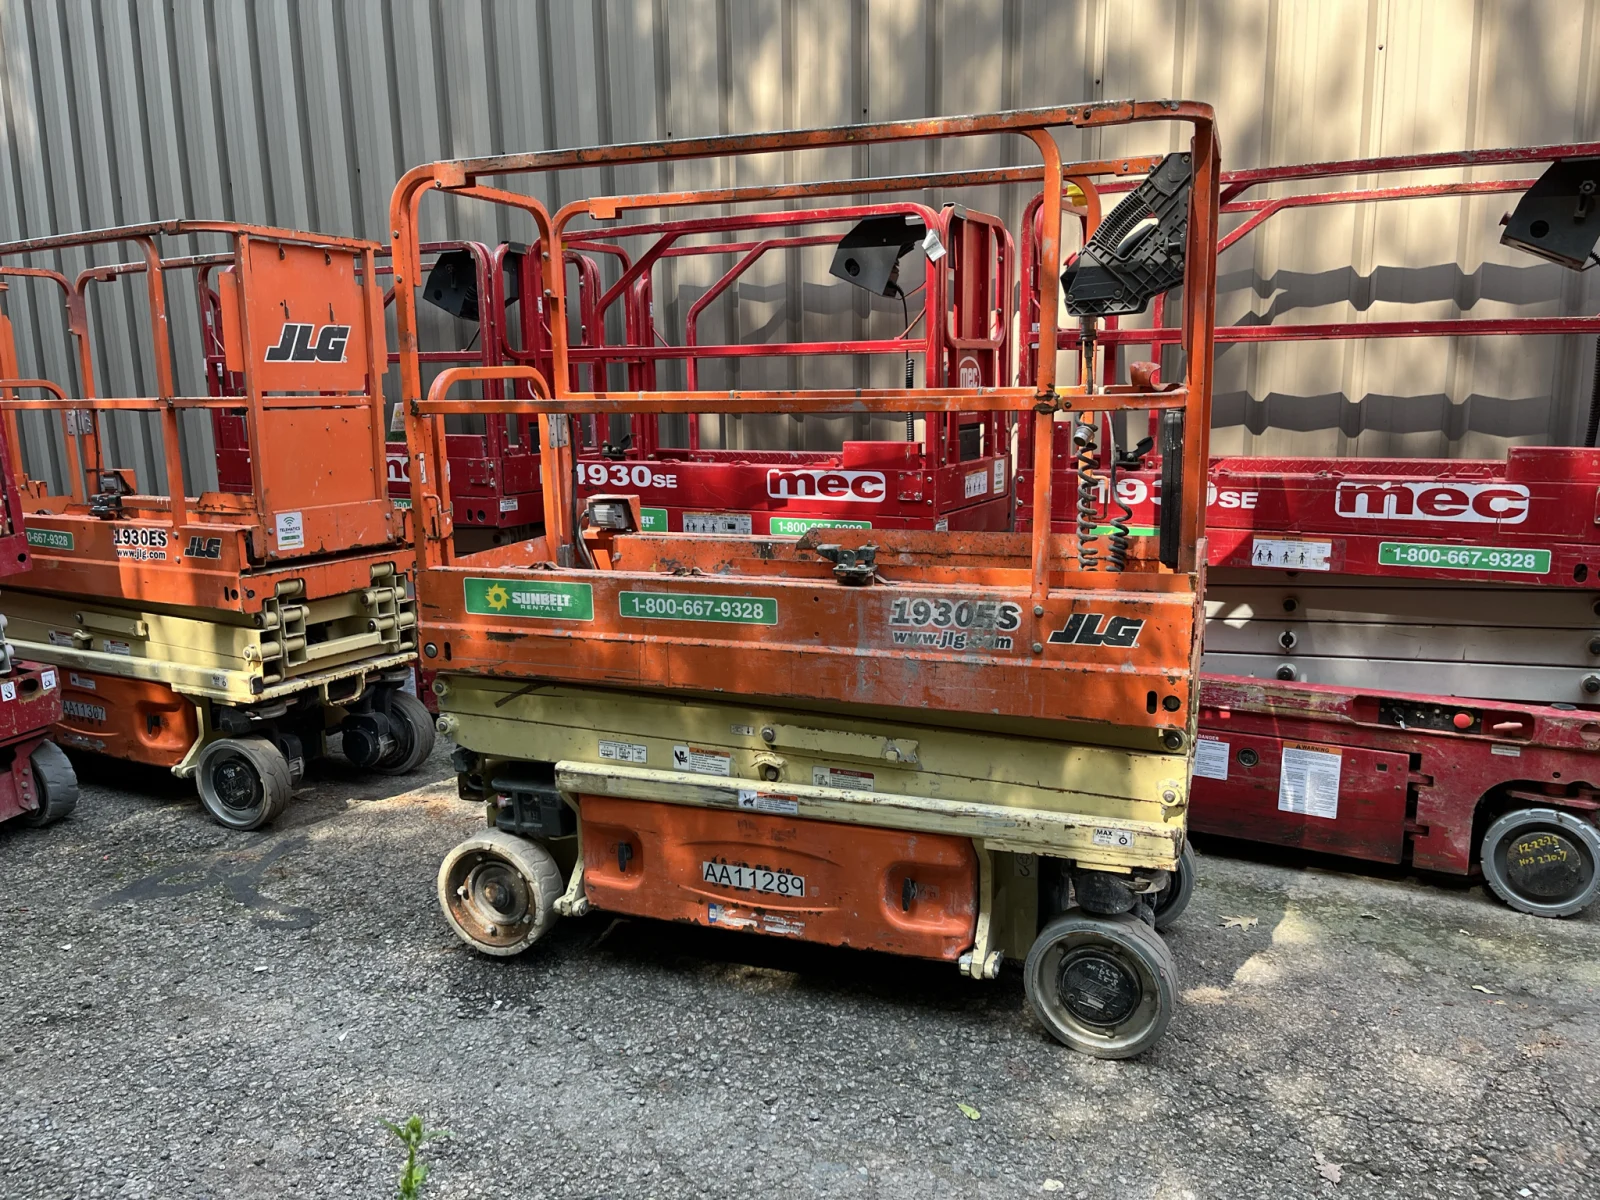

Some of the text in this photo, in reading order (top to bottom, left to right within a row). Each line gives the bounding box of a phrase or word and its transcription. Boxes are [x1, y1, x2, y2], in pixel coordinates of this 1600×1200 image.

[264, 323, 351, 363] JLG
[961, 367, 978, 389] mec
[577, 463, 678, 488] 1930SE
[768, 470, 885, 500] mec
[1338, 483, 1528, 521] mec
[114, 528, 166, 546] 1930ES
[184, 536, 222, 558] JLG
[116, 548, 166, 561] www.jlg.com
[1393, 546, 1536, 569] 1-800-667-9328
[512, 591, 571, 606] SUNBELT
[631, 597, 764, 620] 1-800-667-9328
[1047, 613, 1146, 648] JLG
[1302, 744, 1330, 753] WARNING
[704, 863, 804, 897] AA11289
